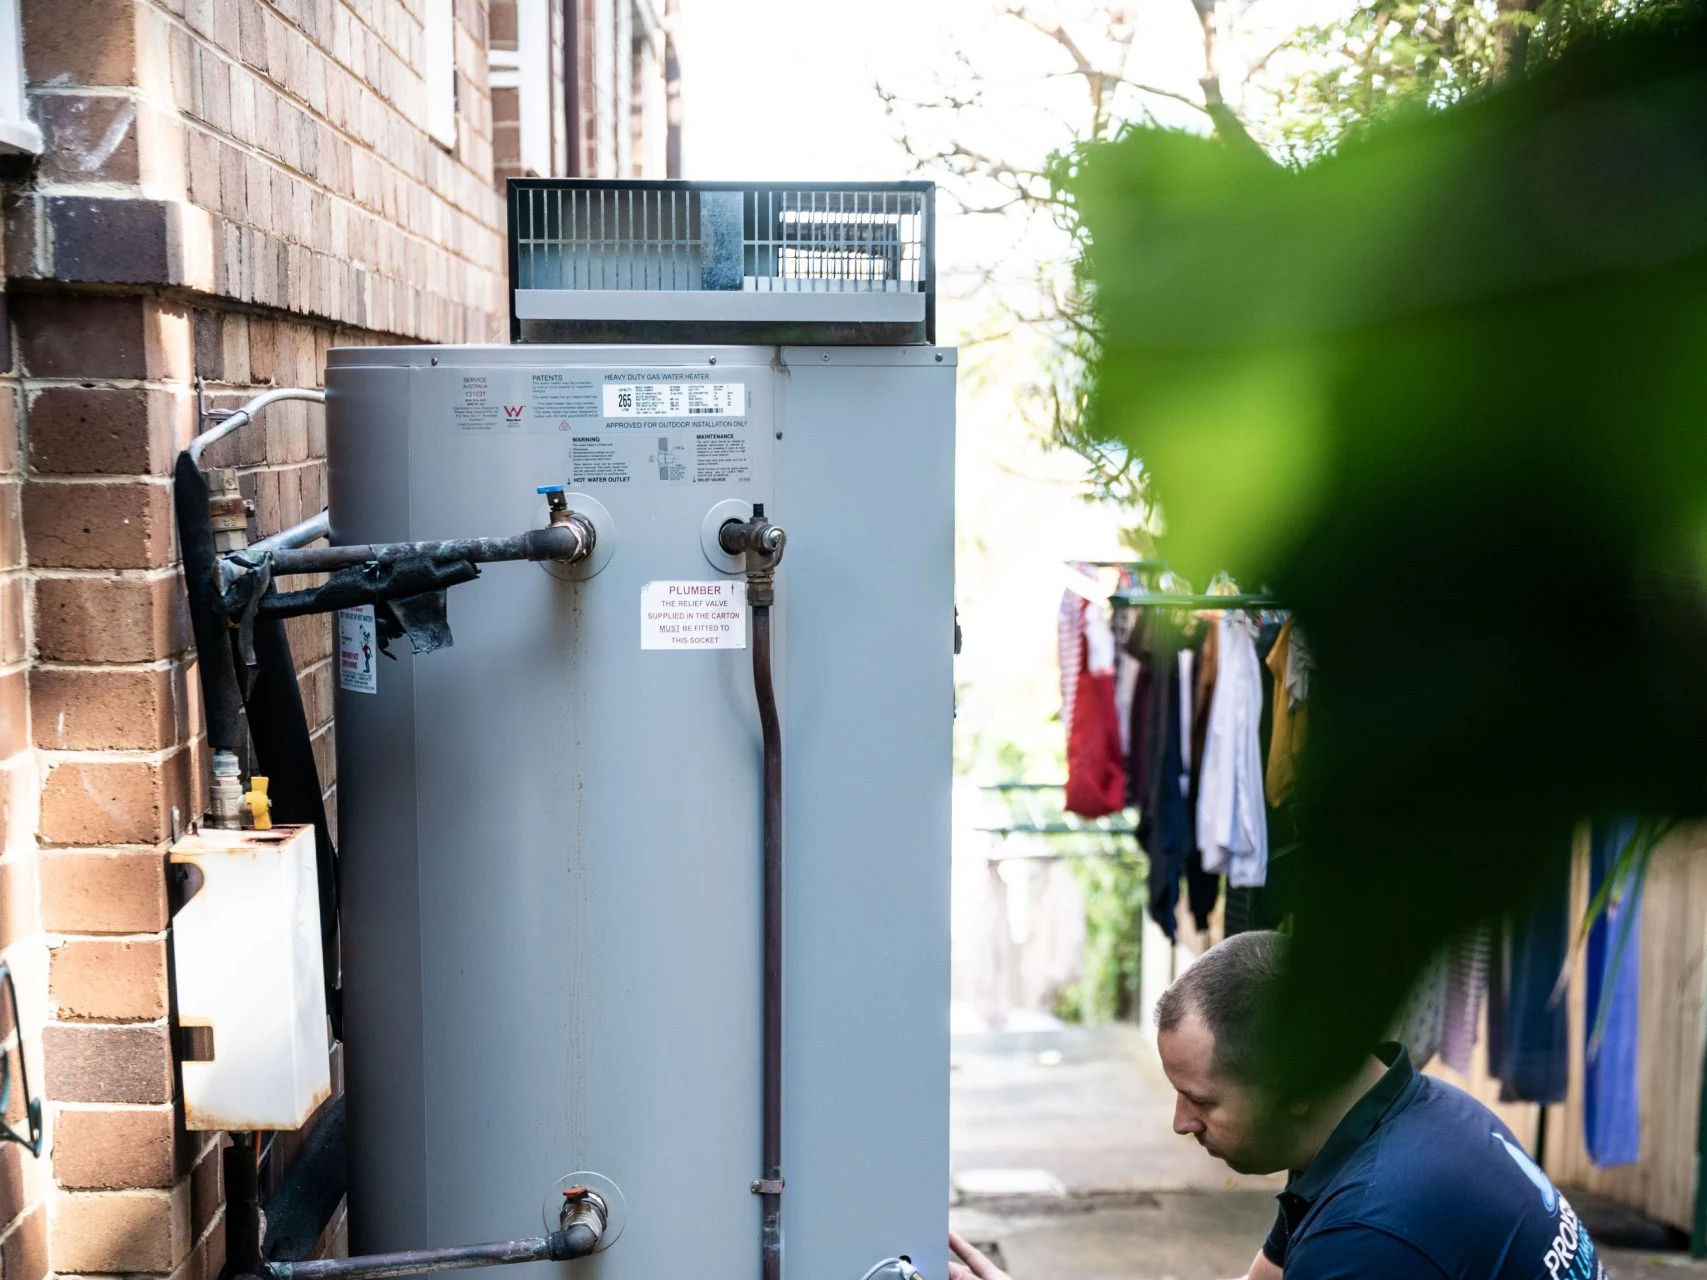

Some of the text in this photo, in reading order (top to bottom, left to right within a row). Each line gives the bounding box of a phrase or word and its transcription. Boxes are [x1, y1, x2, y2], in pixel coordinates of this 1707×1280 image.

[604, 373, 626, 381] HEAVY
[627, 373, 645, 381] DUTY
[647, 373, 660, 381] GAS
[618, 393, 632, 408] 265
[669, 585, 721, 595] PLUMBER
[647, 612, 740, 620] SUPPLIED IN THE CARTON
[659, 624, 730, 633] MUST BE FITTED TO
